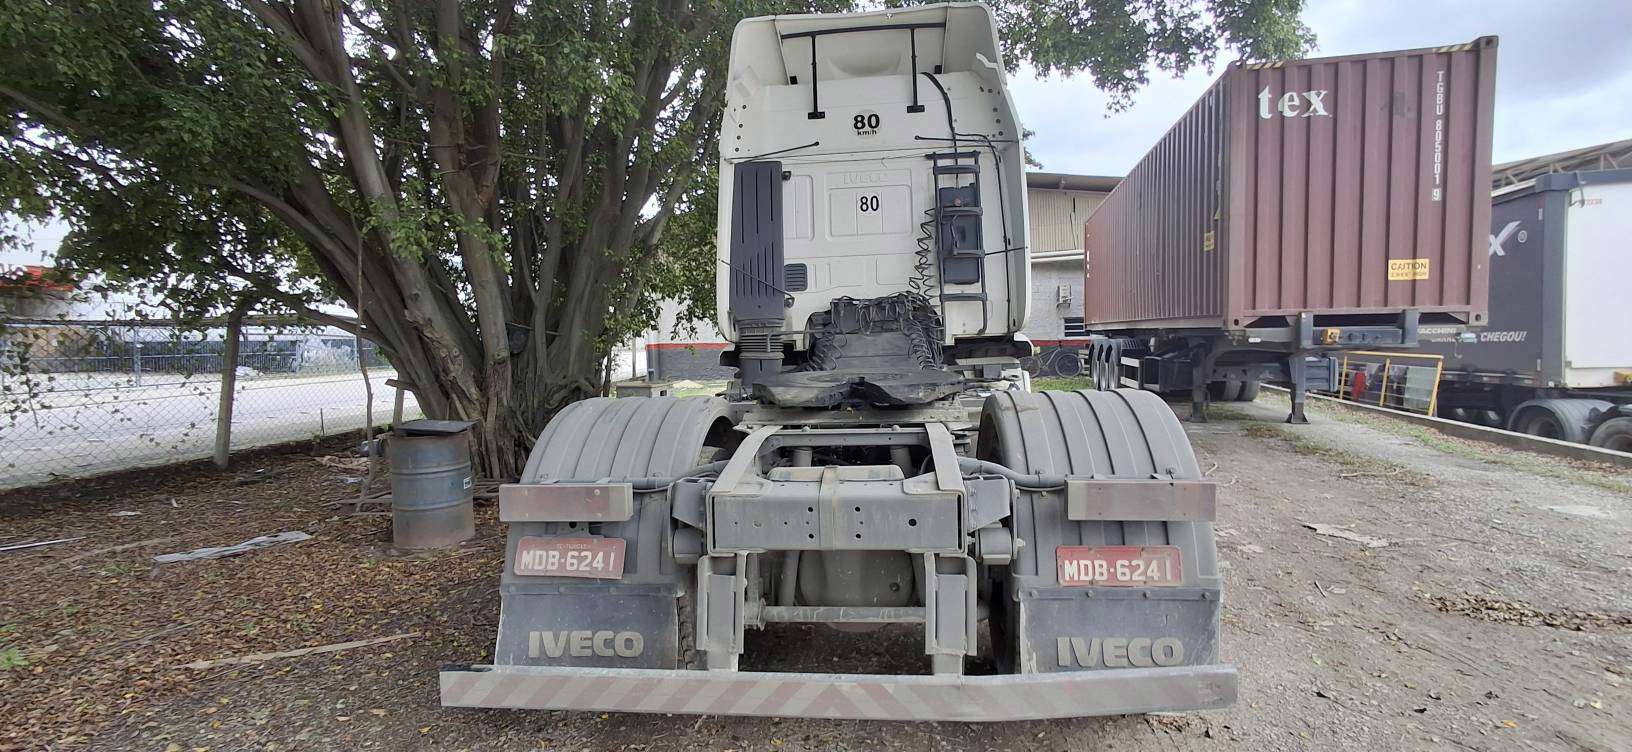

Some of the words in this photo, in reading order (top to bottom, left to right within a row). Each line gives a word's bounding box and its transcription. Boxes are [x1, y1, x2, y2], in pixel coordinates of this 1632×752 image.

[1258, 85, 1329, 119] tex
[1435, 70, 1445, 115] TGBU
[853, 113, 880, 130] 80
[1434, 119, 1442, 184] 805001
[860, 195, 879, 212] 80
[1480, 331, 1527, 342] CHEGOU!
[519, 550, 616, 571] MDB-6241
[1063, 559, 1174, 581] MDB-6241
[528, 630, 644, 658] IVECO
[1056, 637, 1184, 668] IVECO
